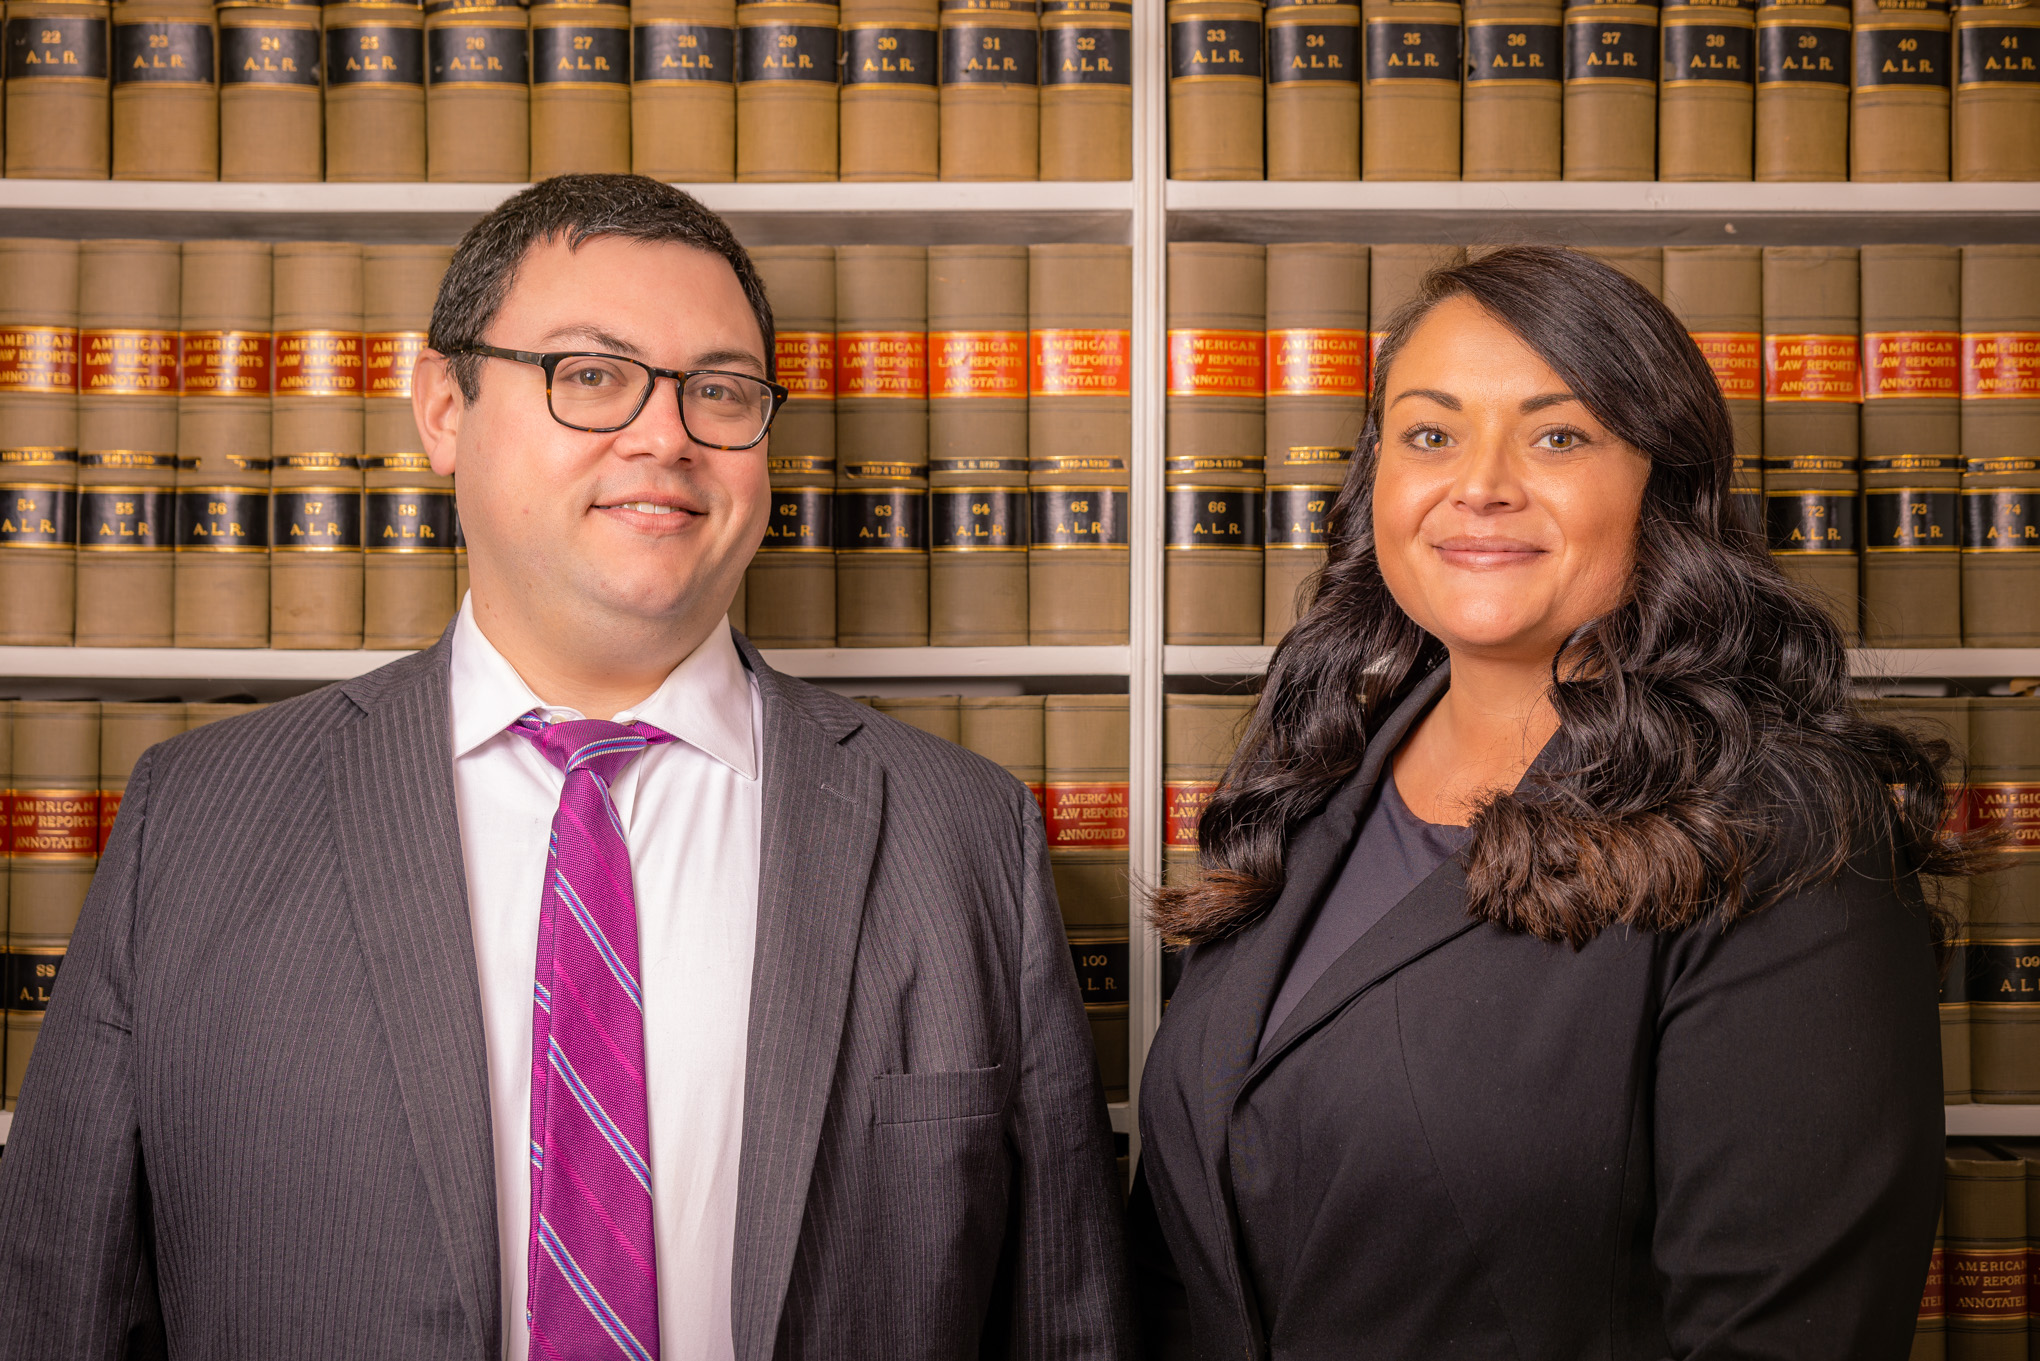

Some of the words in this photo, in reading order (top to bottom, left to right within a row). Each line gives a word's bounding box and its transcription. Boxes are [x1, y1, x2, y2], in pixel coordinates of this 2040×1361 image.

[41, 30, 62, 44] 22
[149, 34, 168, 48] 23
[678, 35, 697, 48] 28
[778, 35, 797, 48] 29
[1207, 29, 1226, 43] 33
[1306, 34, 1325, 47] 34
[1403, 33, 1422, 46] 35
[1507, 33, 1527, 47] 36
[1602, 32, 1621, 45] 37
[1706, 34, 1726, 48] 38
[1798, 35, 1818, 49] 39
[261, 37, 280, 51] 24
[360, 37, 379, 50] 25
[466, 37, 485, 50] 26
[574, 37, 593, 50] 27
[878, 37, 897, 50] 30
[983, 37, 1001, 50] 31
[1077, 37, 1096, 51] 32
[1898, 39, 1917, 52] 40
[2000, 36, 2018, 49] 41
[91, 338, 171, 351] AMERICAN
[185, 339, 259, 352] AMERICAN
[280, 340, 356, 352] AMERICAN
[372, 341, 428, 353] AMERIC
[776, 342, 829, 354] ERICAN
[848, 341, 922, 353] AMERICAN
[943, 341, 1018, 353] AMERICAN
[1042, 339, 1117, 351] AMERICAN
[1183, 339, 1257, 351] AMERICAN
[1281, 339, 1358, 351] AMERICAN
[1700, 343, 1755, 354] ERICAN
[1780, 344, 1855, 356] AMERICAN
[1878, 342, 1953, 353] AMERICAN
[19, 350, 77, 363] REPORTS
[86, 353, 114, 366] LAW
[117, 354, 176, 367] REPORTS
[183, 354, 203, 367] LAW
[207, 355, 264, 367] REPORTS
[276, 354, 301, 367] LAW
[303, 355, 361, 367] REPORTS
[368, 356, 393, 368] LAW
[843, 356, 870, 369] LAW
[874, 356, 927, 369] REPORTS
[938, 356, 966, 368] LAW
[969, 356, 1022, 368] REPORTS
[1037, 354, 1064, 366] LAW
[1068, 354, 1123, 366] REPORTS
[1177, 354, 1205, 366] LAW
[1208, 354, 1261, 366] REPORTS
[1277, 354, 1303, 366] LAW
[1307, 354, 1361, 366] REPORTS
[779, 357, 833, 369] REPORTS
[1774, 360, 1802, 372] LAW
[1873, 357, 1900, 368] LAW
[1905, 357, 1957, 369] REPORTS
[1970, 357, 1998, 369] LAW
[91, 374, 170, 388] ANNOTATED
[184, 375, 257, 388] ANNOTATED
[280, 375, 356, 388] ANNOTATED
[777, 378, 828, 390] OTATED
[849, 377, 922, 389] ANNOTATED
[944, 376, 1018, 389] ANNOTATED
[1042, 374, 1117, 386] ANNOTATED
[1183, 374, 1256, 386] ANNOTATED
[1281, 374, 1356, 386] ANNOTATED
[1780, 380, 1854, 392] ANNOTATED
[1879, 377, 1953, 389] ANNOTATED
[115, 502, 134, 514] 55
[208, 502, 227, 515] 56
[305, 503, 323, 514] 57
[398, 504, 417, 516] 58
[780, 504, 798, 516] 62
[875, 505, 892, 517] 63
[972, 504, 990, 515] 64
[1071, 502, 1089, 513] 65
[1208, 502, 1226, 514] 66
[1307, 501, 1325, 512] 67
[1807, 506, 1825, 517] 72
[1910, 504, 1927, 515] 73
[2004, 504, 2021, 515] 74
[1059, 793, 1123, 805] AMERICAN
[16, 801, 93, 813] AMERICAN
[1053, 808, 1080, 819] LAW
[1083, 807, 1128, 818] REPORTS
[1170, 806, 1198, 817] LAW
[1979, 808, 2009, 818] LAW
[12, 815, 35, 827] LAW
[38, 815, 97, 827] REPORTS
[1057, 829, 1125, 840] ANNOTATED
[16, 836, 92, 849] ANNOTATED
[1082, 955, 1107, 966] 100
[2015, 956, 2040, 968] 109
[1983, 1276, 2027, 1286] REPORT
